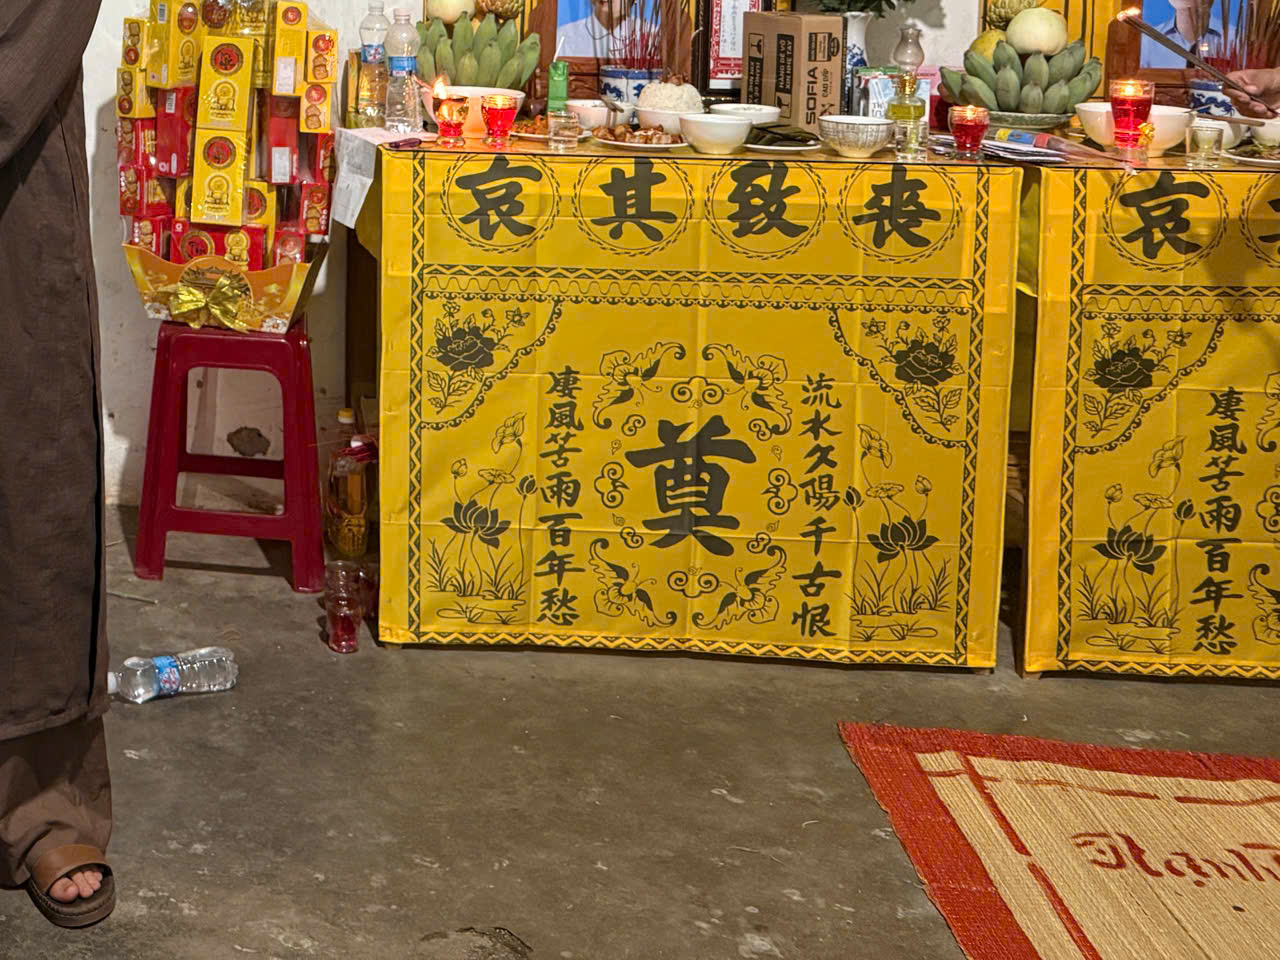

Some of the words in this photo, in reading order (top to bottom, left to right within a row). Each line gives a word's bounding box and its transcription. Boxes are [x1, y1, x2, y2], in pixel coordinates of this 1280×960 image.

[806, 66, 819, 125] SOFIA
[455, 155, 542, 241] 哀
[591, 158, 678, 242] 其
[725, 159, 809, 240] 致
[1119, 171, 1211, 261] 哀
[626, 414, 757, 557] 奠
